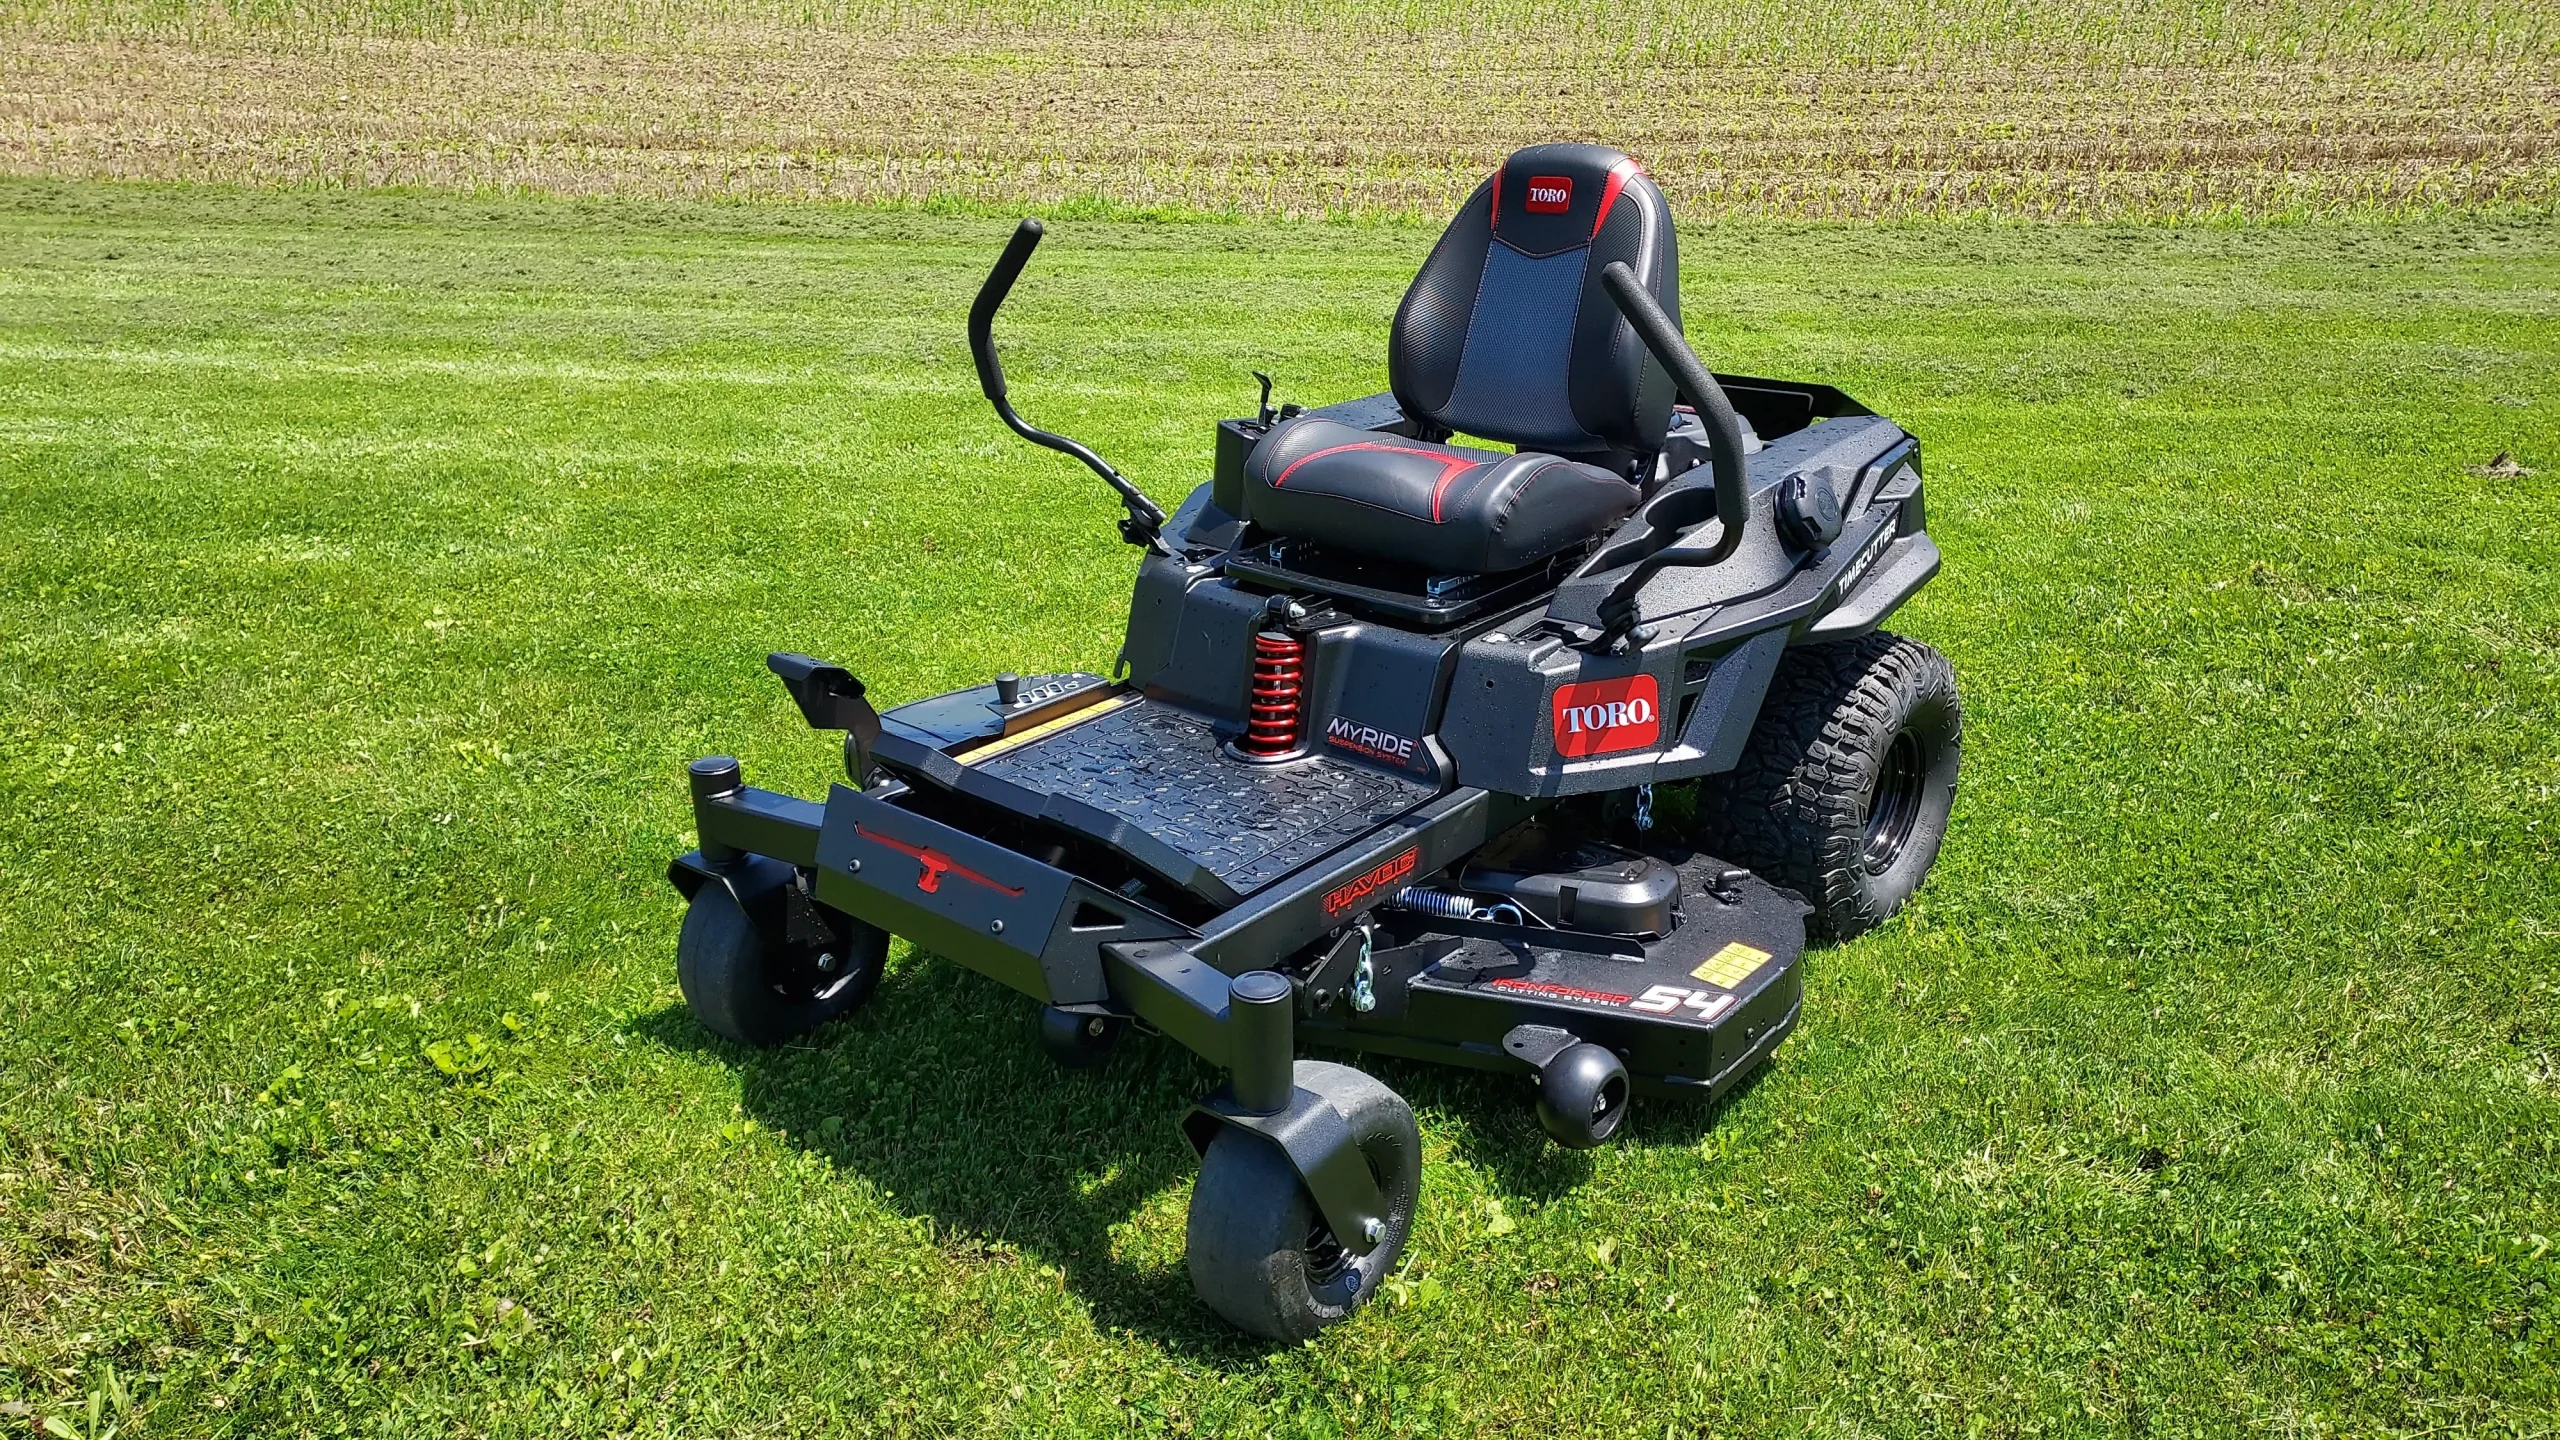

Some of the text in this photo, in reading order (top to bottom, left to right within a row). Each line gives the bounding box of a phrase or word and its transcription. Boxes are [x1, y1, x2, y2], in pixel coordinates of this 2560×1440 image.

[1530, 187, 1567, 203] TORO
[1838, 518, 1897, 595] TIMECUTTER
[1328, 735, 1407, 766] SUSPENSION SYSTEM
[1324, 847, 1419, 913] HAVOC
[1497, 986, 1620, 1008] CUTTING SYSTEM
[1629, 984, 1736, 1021] 54
